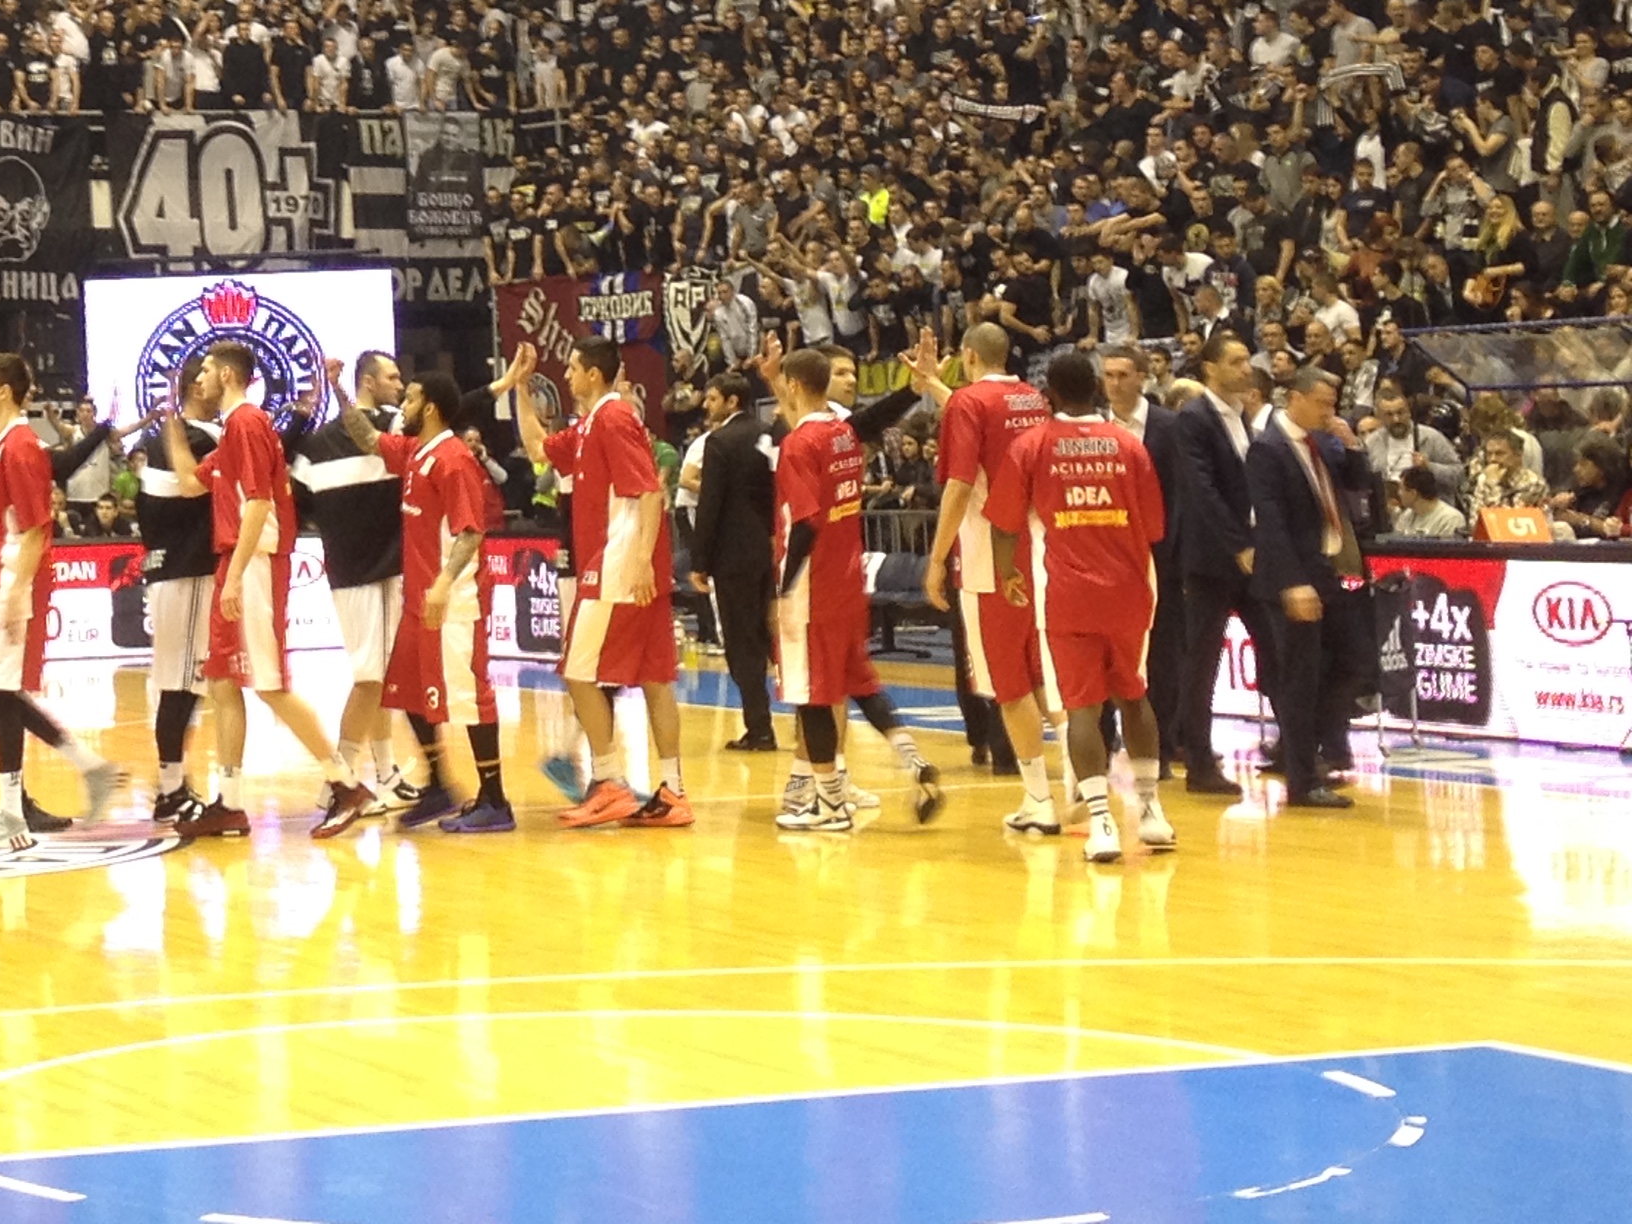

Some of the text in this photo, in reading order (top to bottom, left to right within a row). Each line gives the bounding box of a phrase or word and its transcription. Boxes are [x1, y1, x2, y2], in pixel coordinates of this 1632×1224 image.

[1411, 592, 1473, 642] +4x
[1545, 596, 1601, 632] KIA
[426, 686, 440, 710] 3
[1416, 671, 1479, 704] GUME
